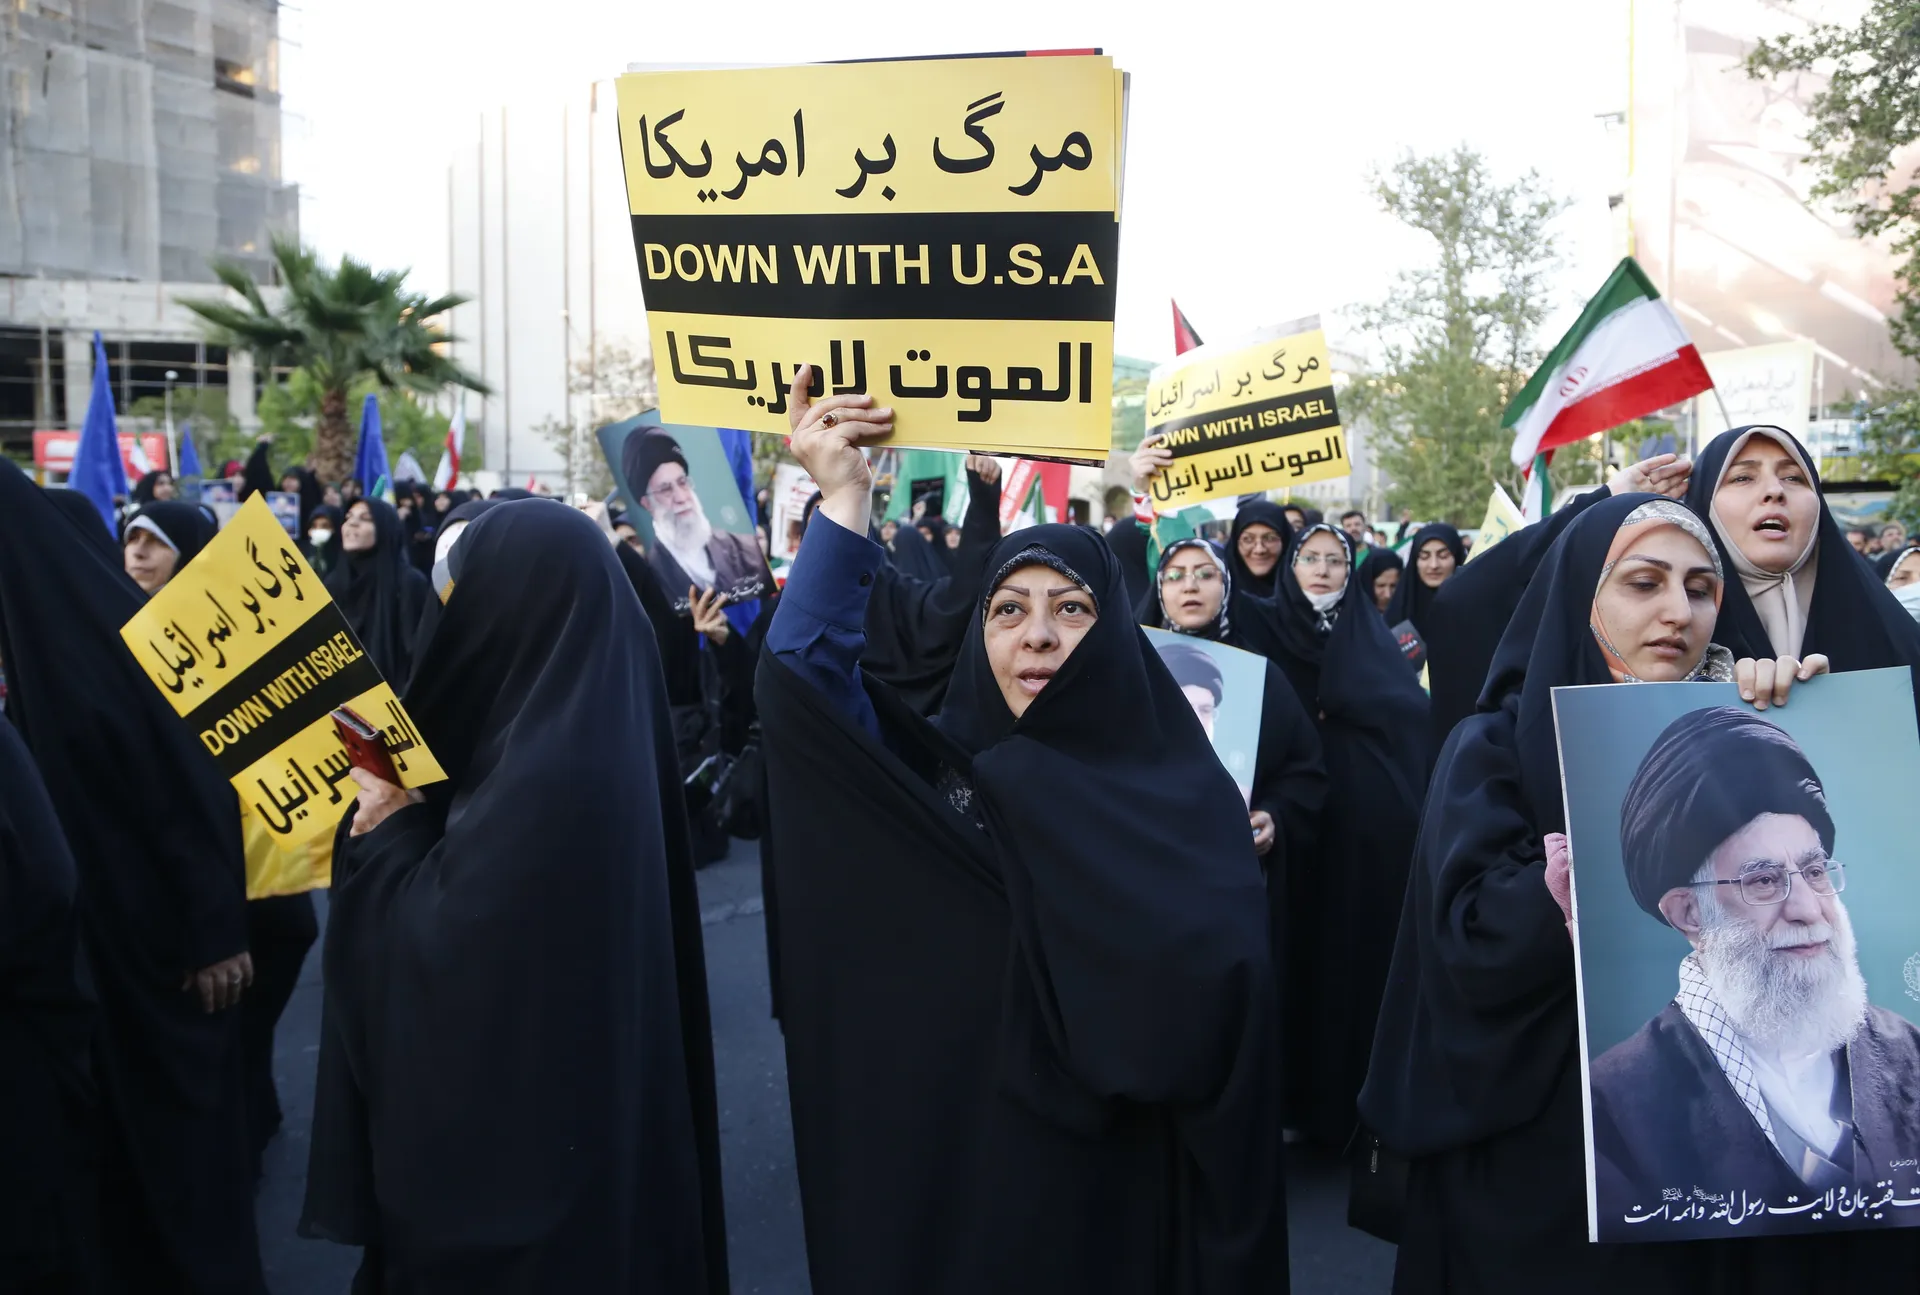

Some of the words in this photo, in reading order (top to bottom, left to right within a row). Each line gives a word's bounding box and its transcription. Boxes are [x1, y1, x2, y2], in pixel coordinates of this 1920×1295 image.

[638, 107, 806, 204] امریکا
[835, 133, 898, 202] بر
[932, 91, 1093, 197] مرگ
[643, 242, 779, 284] DOWN
[792, 243, 931, 285] WITH
[951, 243, 1104, 286] U.S.A
[889, 341, 1092, 423] الموت
[1231, 370, 1252, 397] بر
[1262, 349, 1320, 384] مرگ
[1151, 369, 1221, 417] اسرائیل
[1152, 426, 1200, 449] OWN
[1203, 415, 1254, 440] WITH
[1258, 399, 1334, 428] ISRAEL
[1152, 453, 1254, 502] لاسرائیل
[1260, 435, 1343, 477] الموت
[245, 535, 304, 602] مرگ
[240, 585, 277, 635] بر
[149, 589, 239, 694] اسرائیل
[199, 695, 273, 757] DOWN
[261, 662, 319, 711] WITH
[305, 631, 364, 681] ISRAEL
[1623, 1203, 1669, 1224] است
